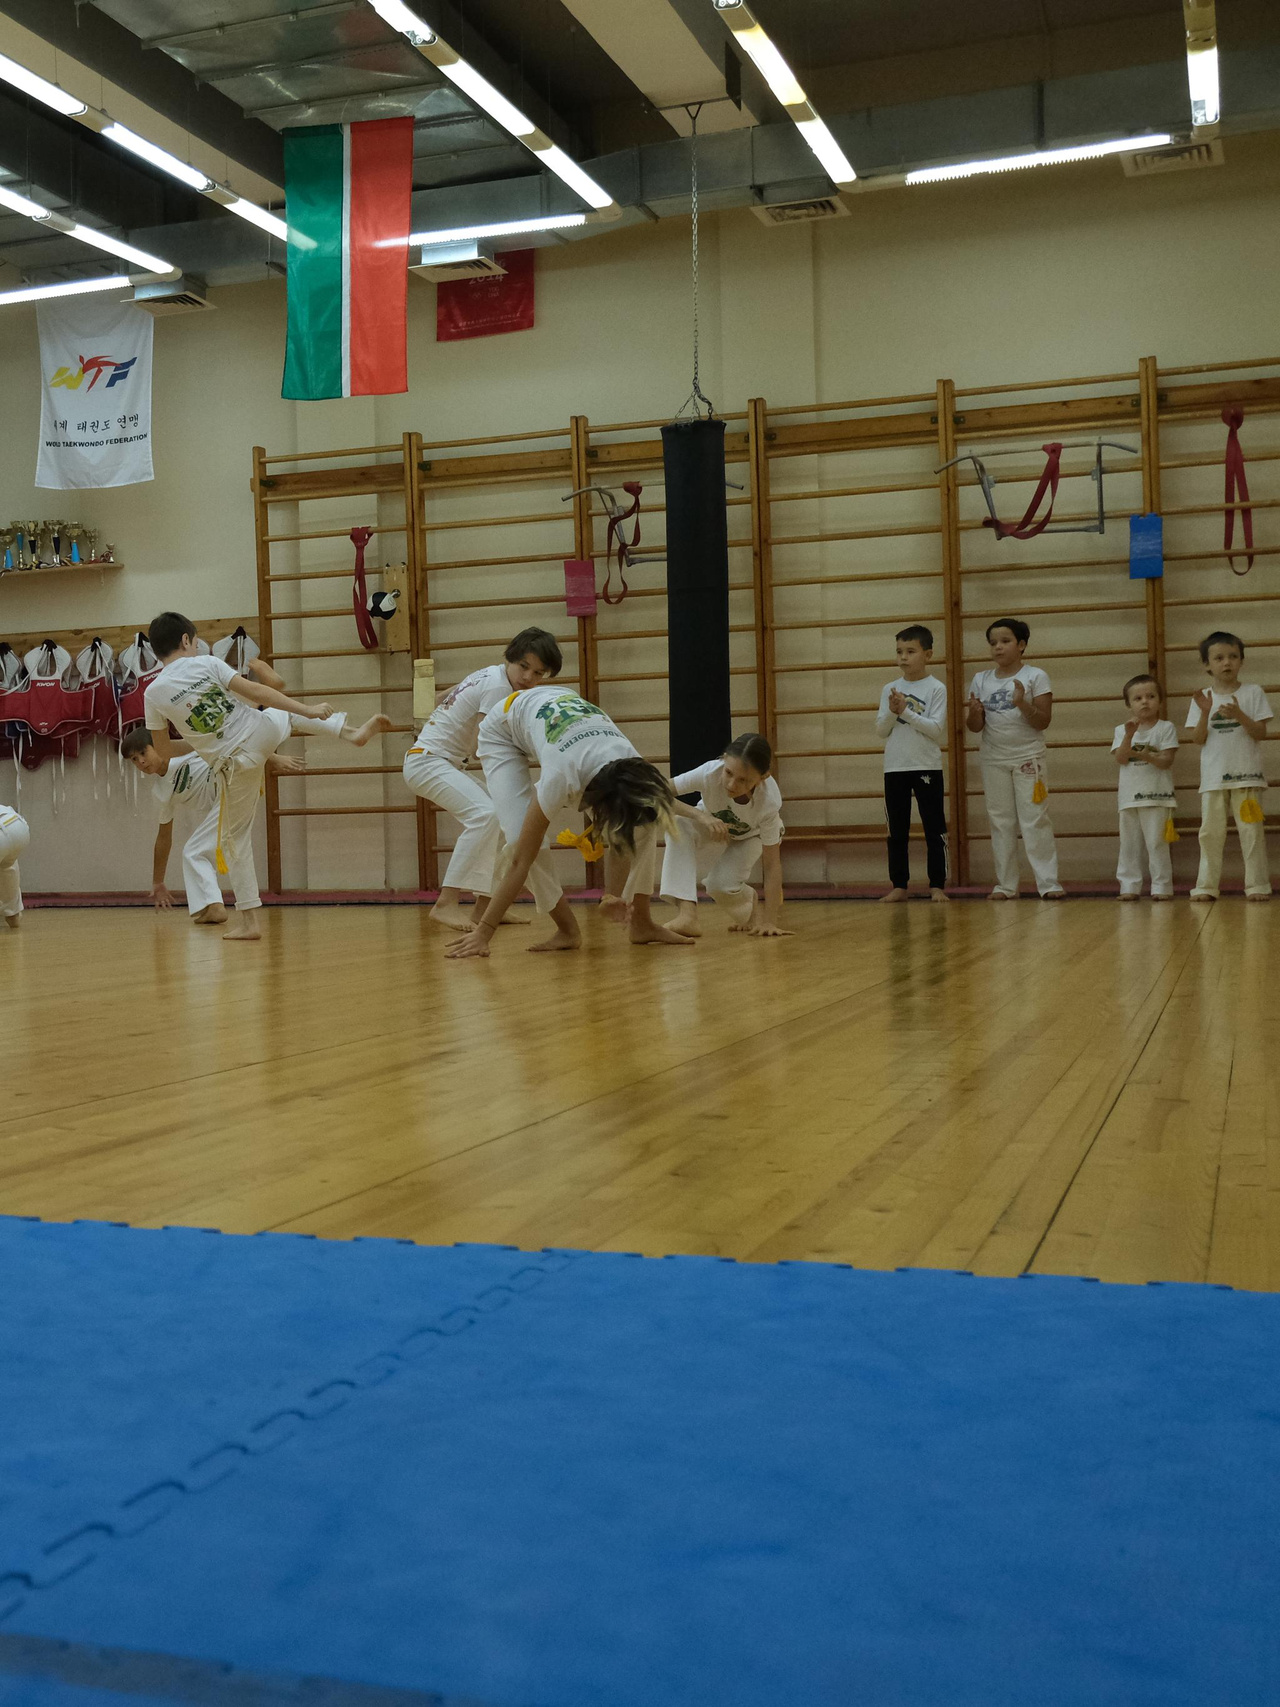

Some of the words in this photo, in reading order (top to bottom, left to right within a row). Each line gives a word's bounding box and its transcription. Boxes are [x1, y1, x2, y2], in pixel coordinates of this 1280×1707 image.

[49, 355, 138, 393] WTF
[77, 419, 111, 433] 태권도
[116, 413, 139, 429] 연맹
[105, 432, 148, 445] FEDERATION
